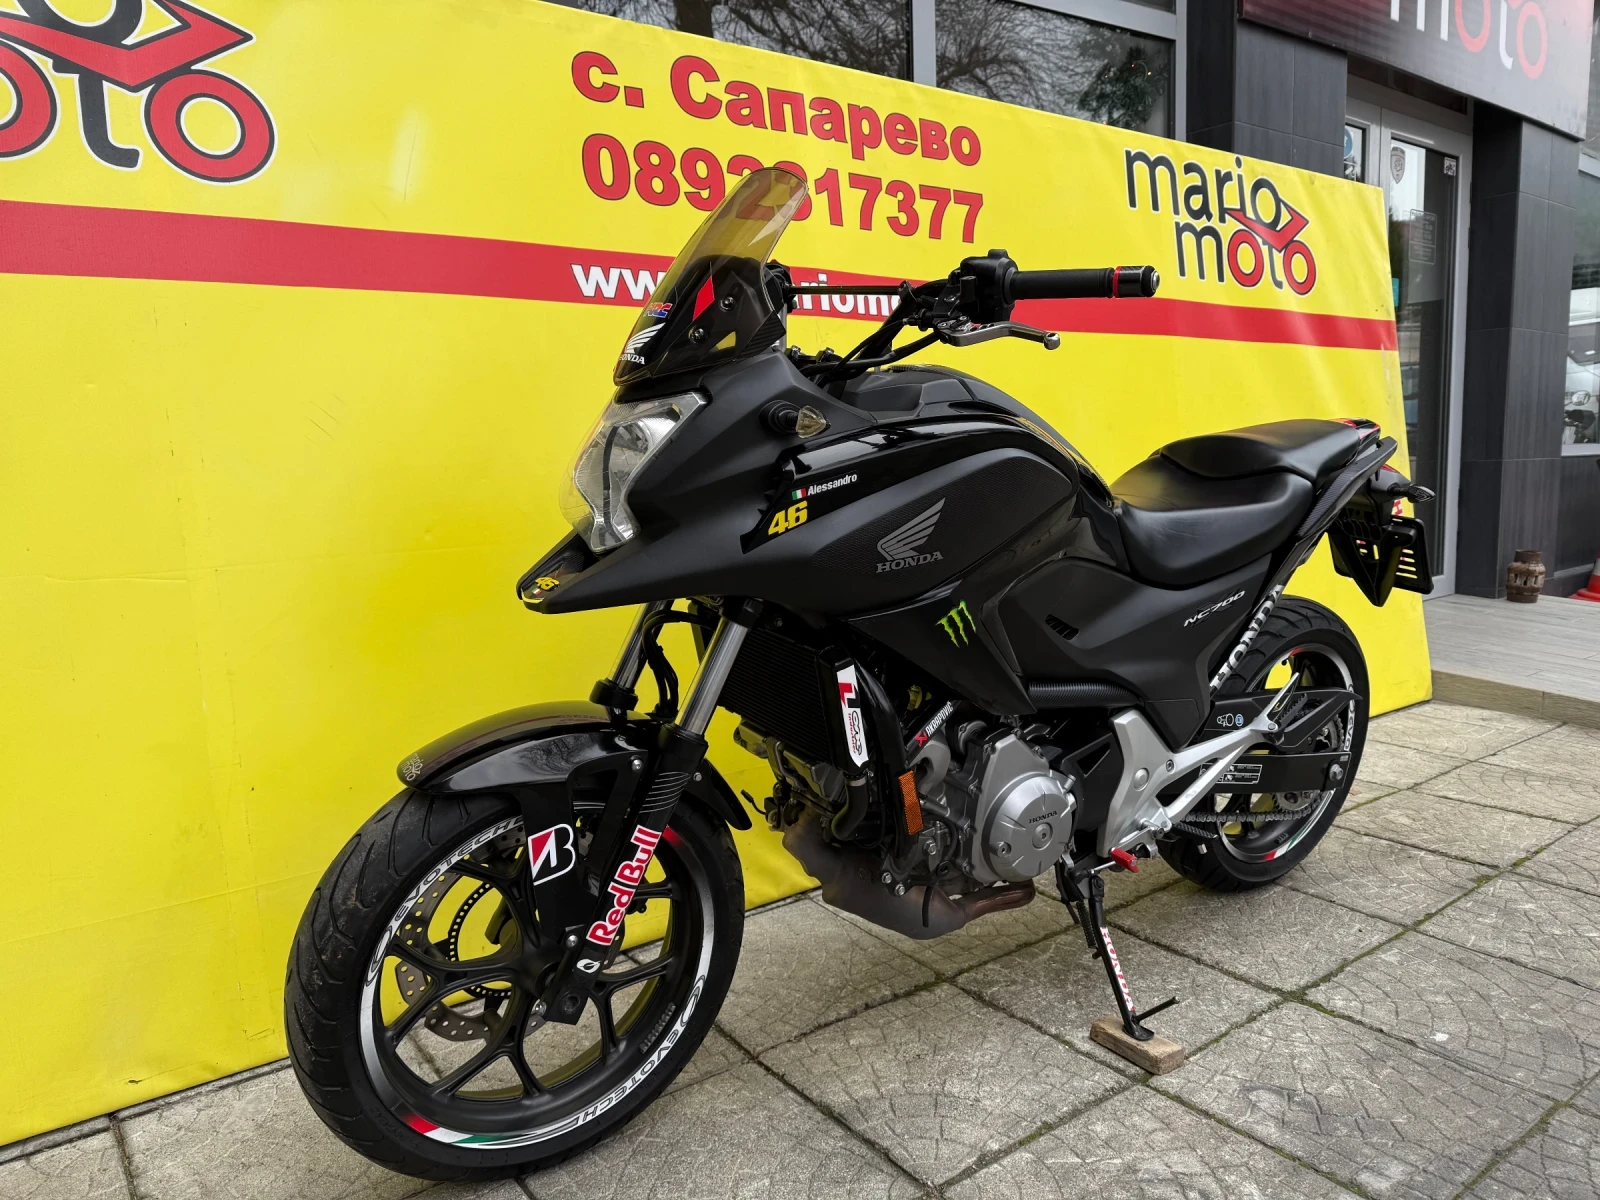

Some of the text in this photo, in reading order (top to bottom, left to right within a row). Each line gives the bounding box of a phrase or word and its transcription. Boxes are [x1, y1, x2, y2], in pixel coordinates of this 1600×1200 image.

[571, 51, 982, 167] с. Сапарево
[1124, 148, 1283, 231] mario
[1174, 216, 1317, 296] moto
[768, 500, 808, 536] 46
[807, 474, 858, 497] Alessandro
[876, 551, 944, 574] HONDA
[1209, 584, 1285, 690] HONDA
[1028, 810, 1058, 825] HONDA
[394, 818, 511, 922] EVOTECH
[582, 1028, 680, 1123] EVOTECH
